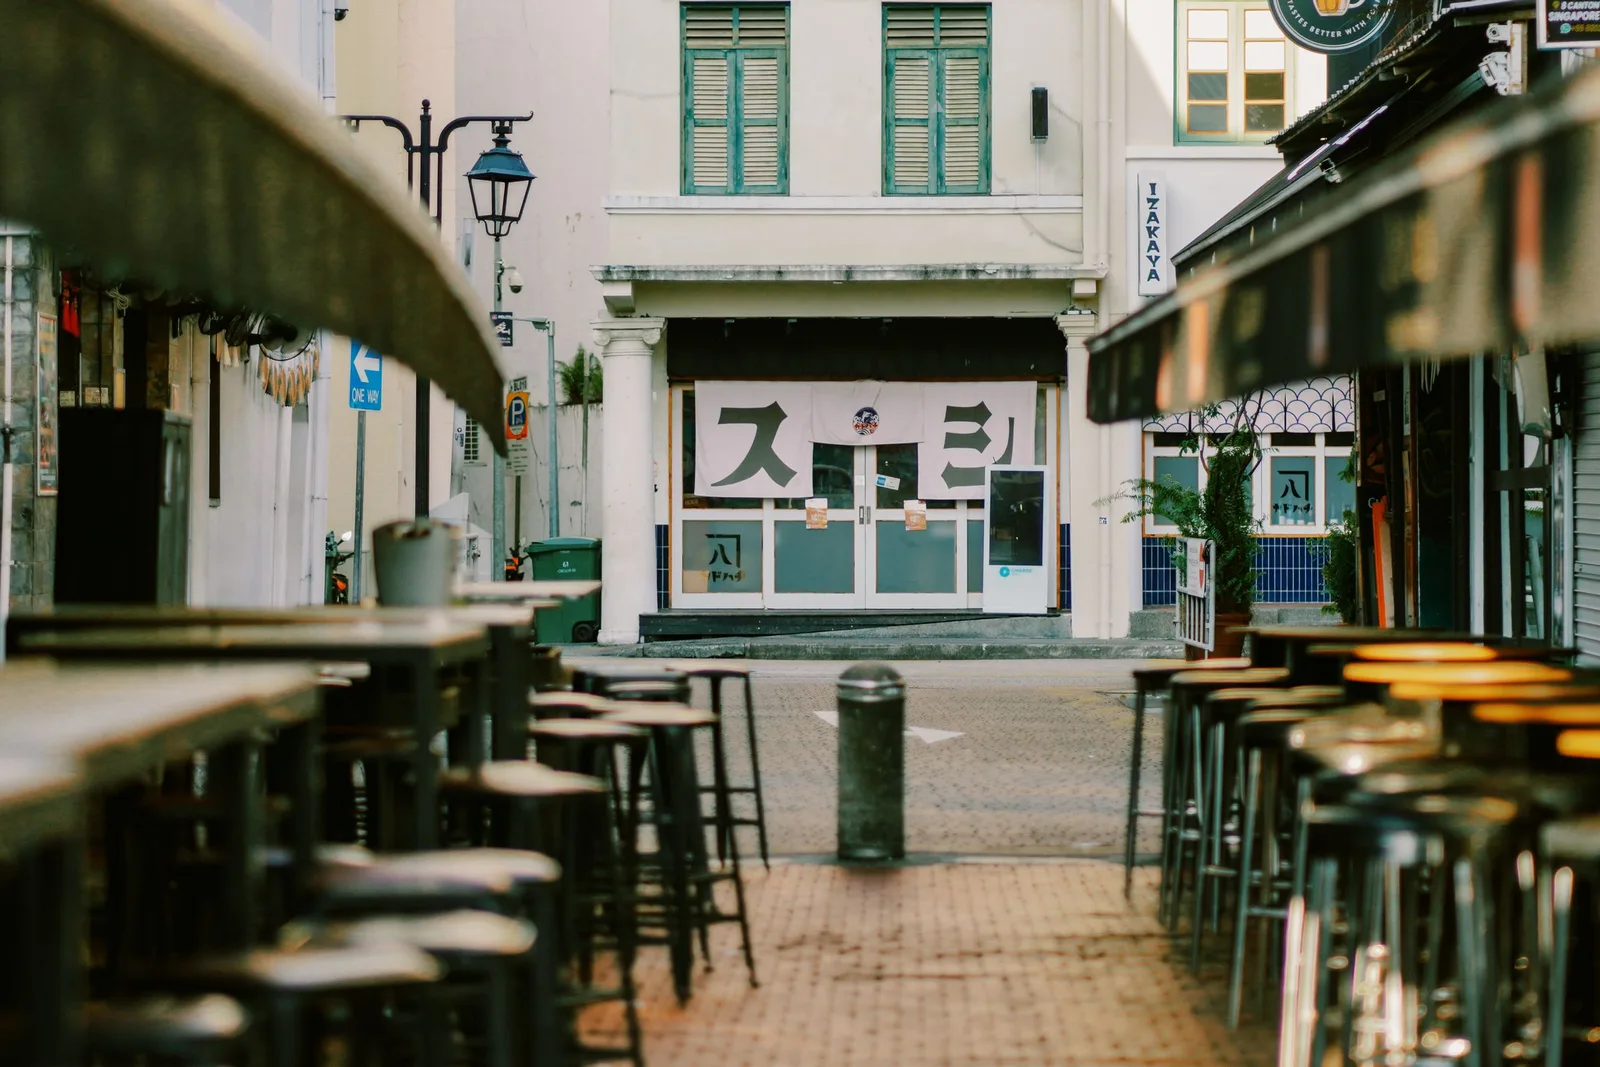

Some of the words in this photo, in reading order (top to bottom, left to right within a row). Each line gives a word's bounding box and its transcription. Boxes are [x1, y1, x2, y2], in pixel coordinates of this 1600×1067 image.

[1286, 0, 1308, 28] TASTES
[1309, 25, 1342, 37] BETTER
[1344, 20, 1367, 35] WITH
[1548, 11, 1600, 21] SINGAPORE
[1145, 183, 1160, 281] IZAKAYA
[351, 387, 365, 402] ONE
[366, 389, 380, 404] WAY
[511, 399, 525, 426] P
[711, 400, 798, 488] ス
